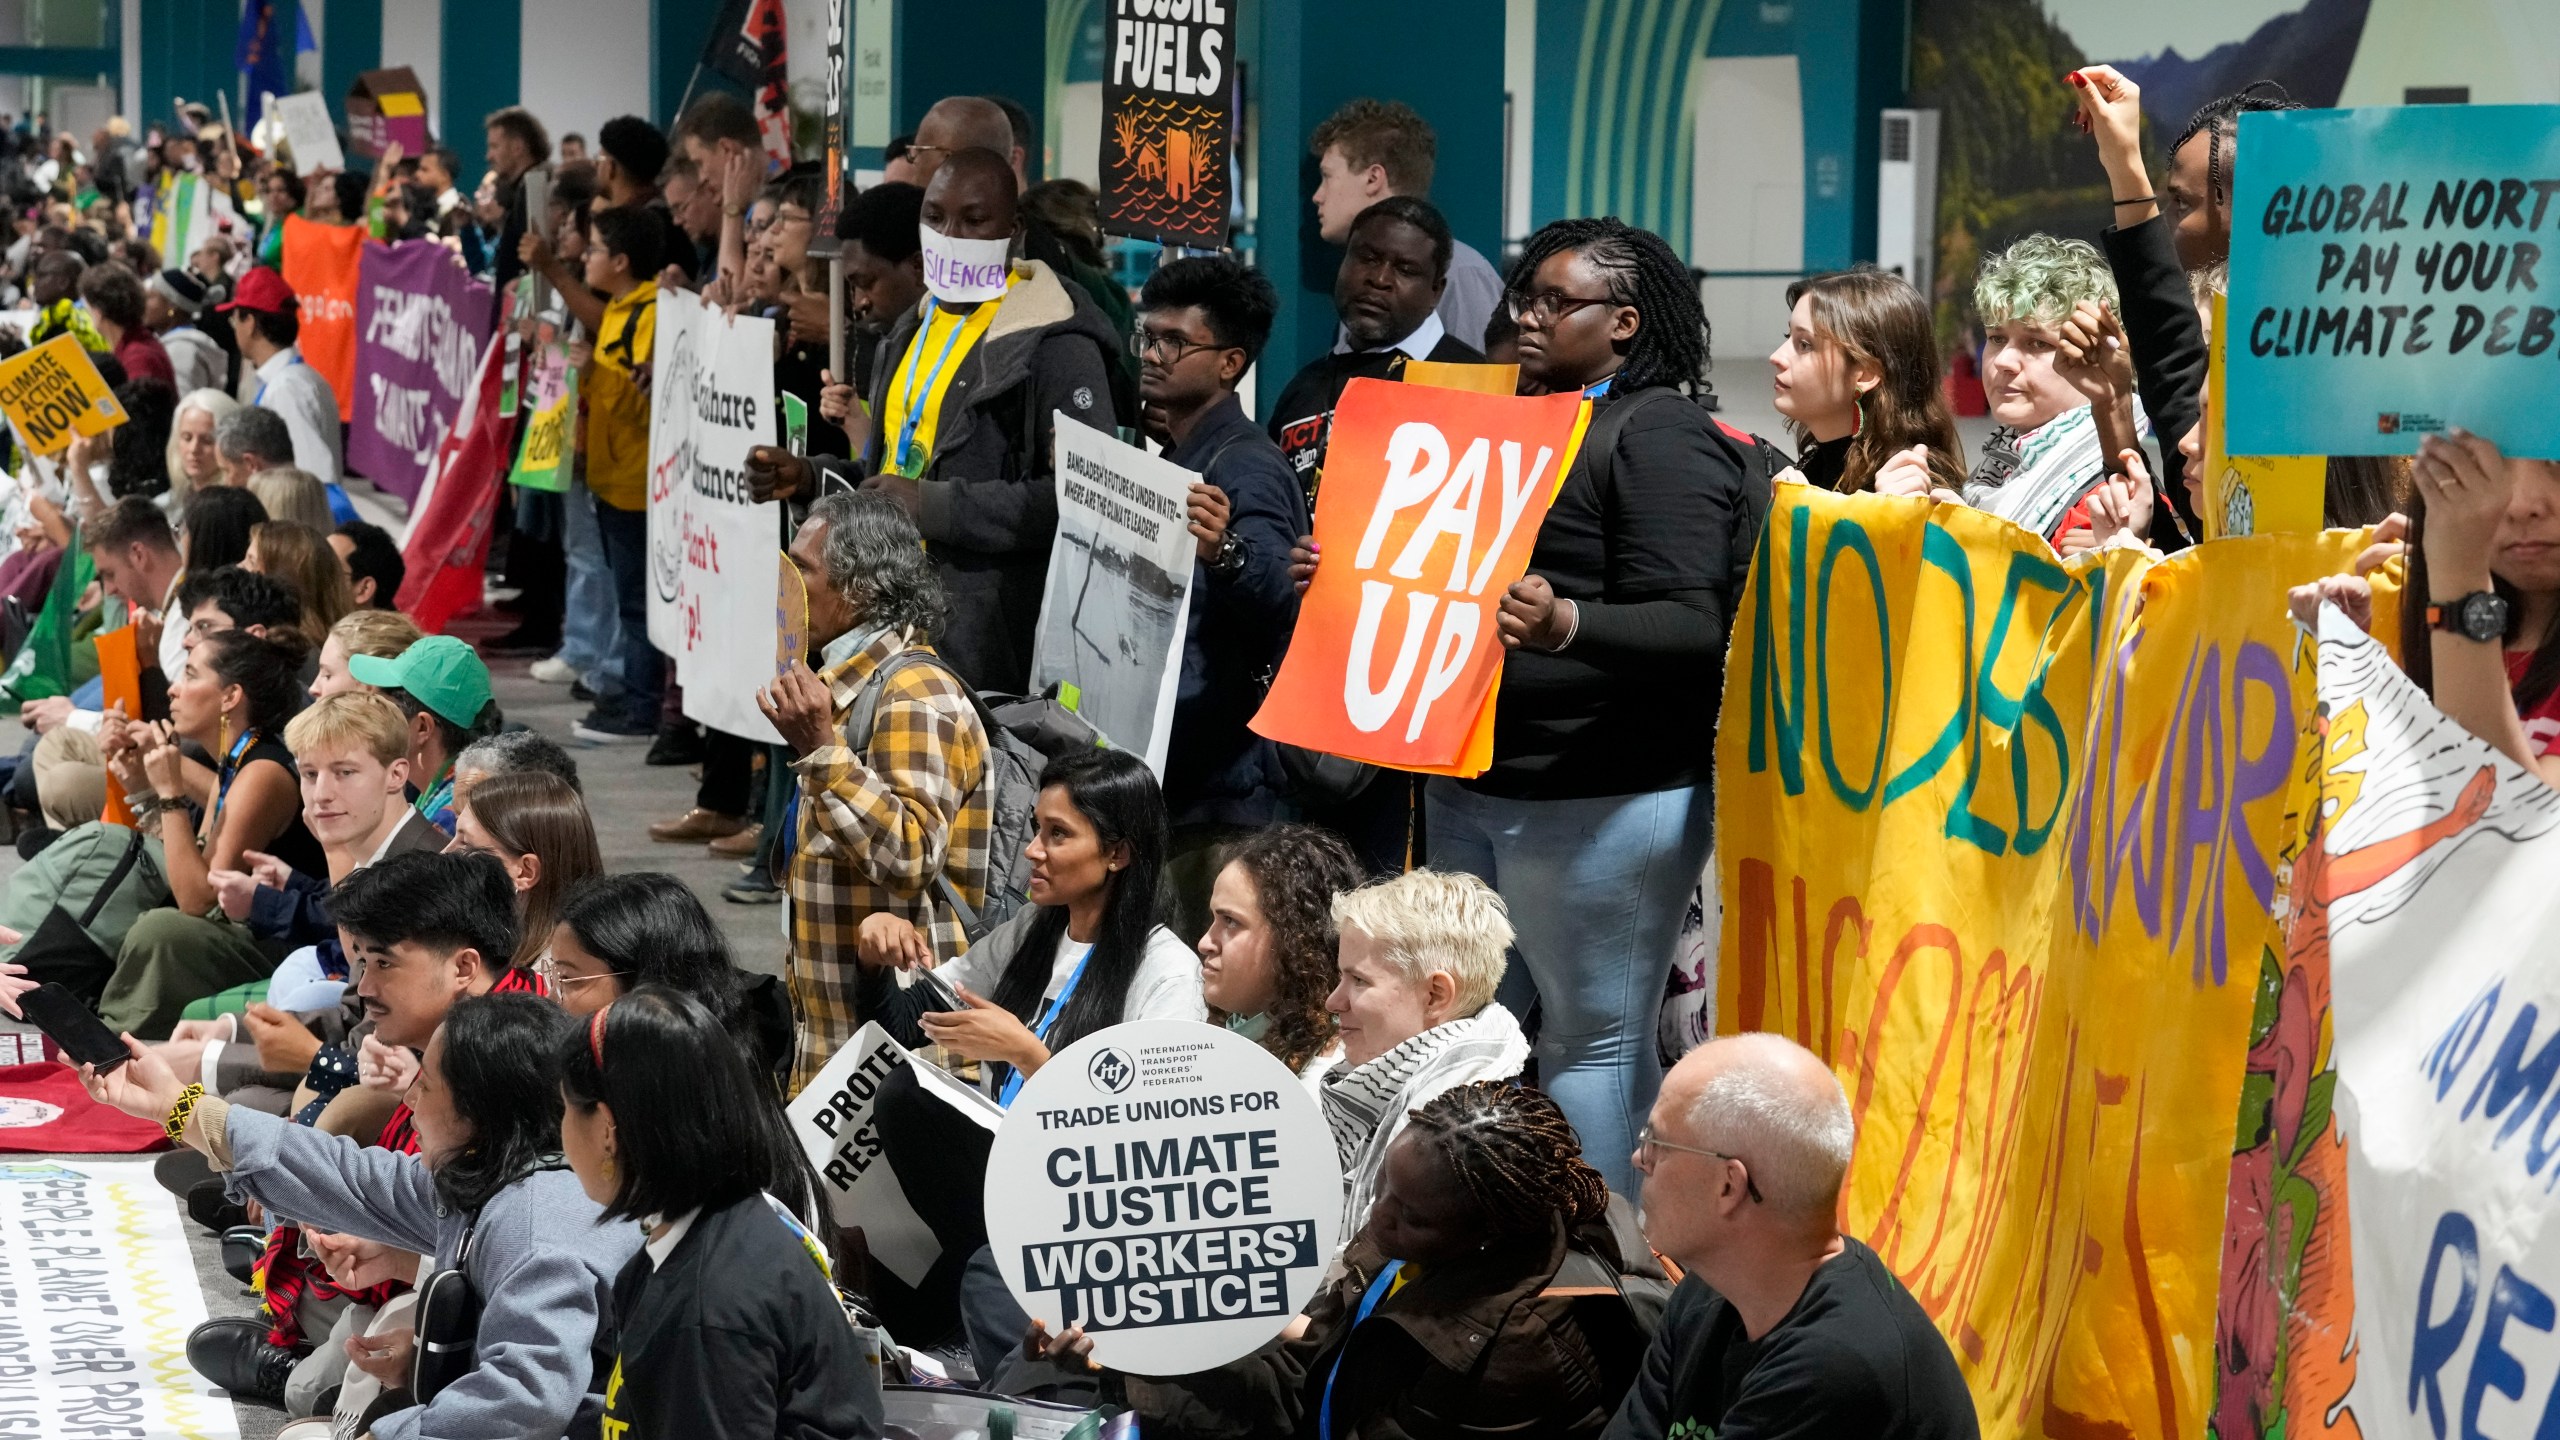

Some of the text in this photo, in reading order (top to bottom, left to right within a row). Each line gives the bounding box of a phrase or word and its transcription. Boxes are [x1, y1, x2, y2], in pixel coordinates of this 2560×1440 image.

[1113, 19, 1223, 96] FUELS
[2262, 178, 2560, 237] GLOBAL NORT
[925, 248, 1006, 289] SILENCED
[2316, 241, 2541, 295] PAY YOUR
[2250, 304, 2560, 357] CLIMATE DEB
[0, 351, 57, 405] CLIMATE
[20, 366, 71, 417] ACTION
[25, 382, 90, 447] NOW
[1067, 450, 1108, 488] BANGLADESH'S
[1107, 470, 1129, 497] FUTURE
[1129, 480, 1135, 500] IS
[1135, 483, 1156, 512] UNDER
[1355, 422, 1553, 596] PAY
[1064, 478, 1159, 544] WHERE ARE THE CLIMATE LEADERS?
[1344, 580, 1480, 743] UP
[1748, 503, 1892, 813] NO
[1099, 1061, 1124, 1084] itf
[1140, 1043, 1215, 1055] INTERNATIONAL
[1141, 1055, 1198, 1066] TRANSPORT
[1143, 1075, 1203, 1086] FEDERATION
[1037, 1091, 1280, 1130] TRADE UNIONS FOR
[1046, 1129, 1280, 1188] CLIMATE
[1062, 1175, 1272, 1232] JUSTICE
[29, 1246, 119, 1316] PLANET
[1071, 1271, 1281, 1330] JUSTICE
[50, 1321, 137, 1375] OVER
[2408, 1211, 2560, 1440] RE
